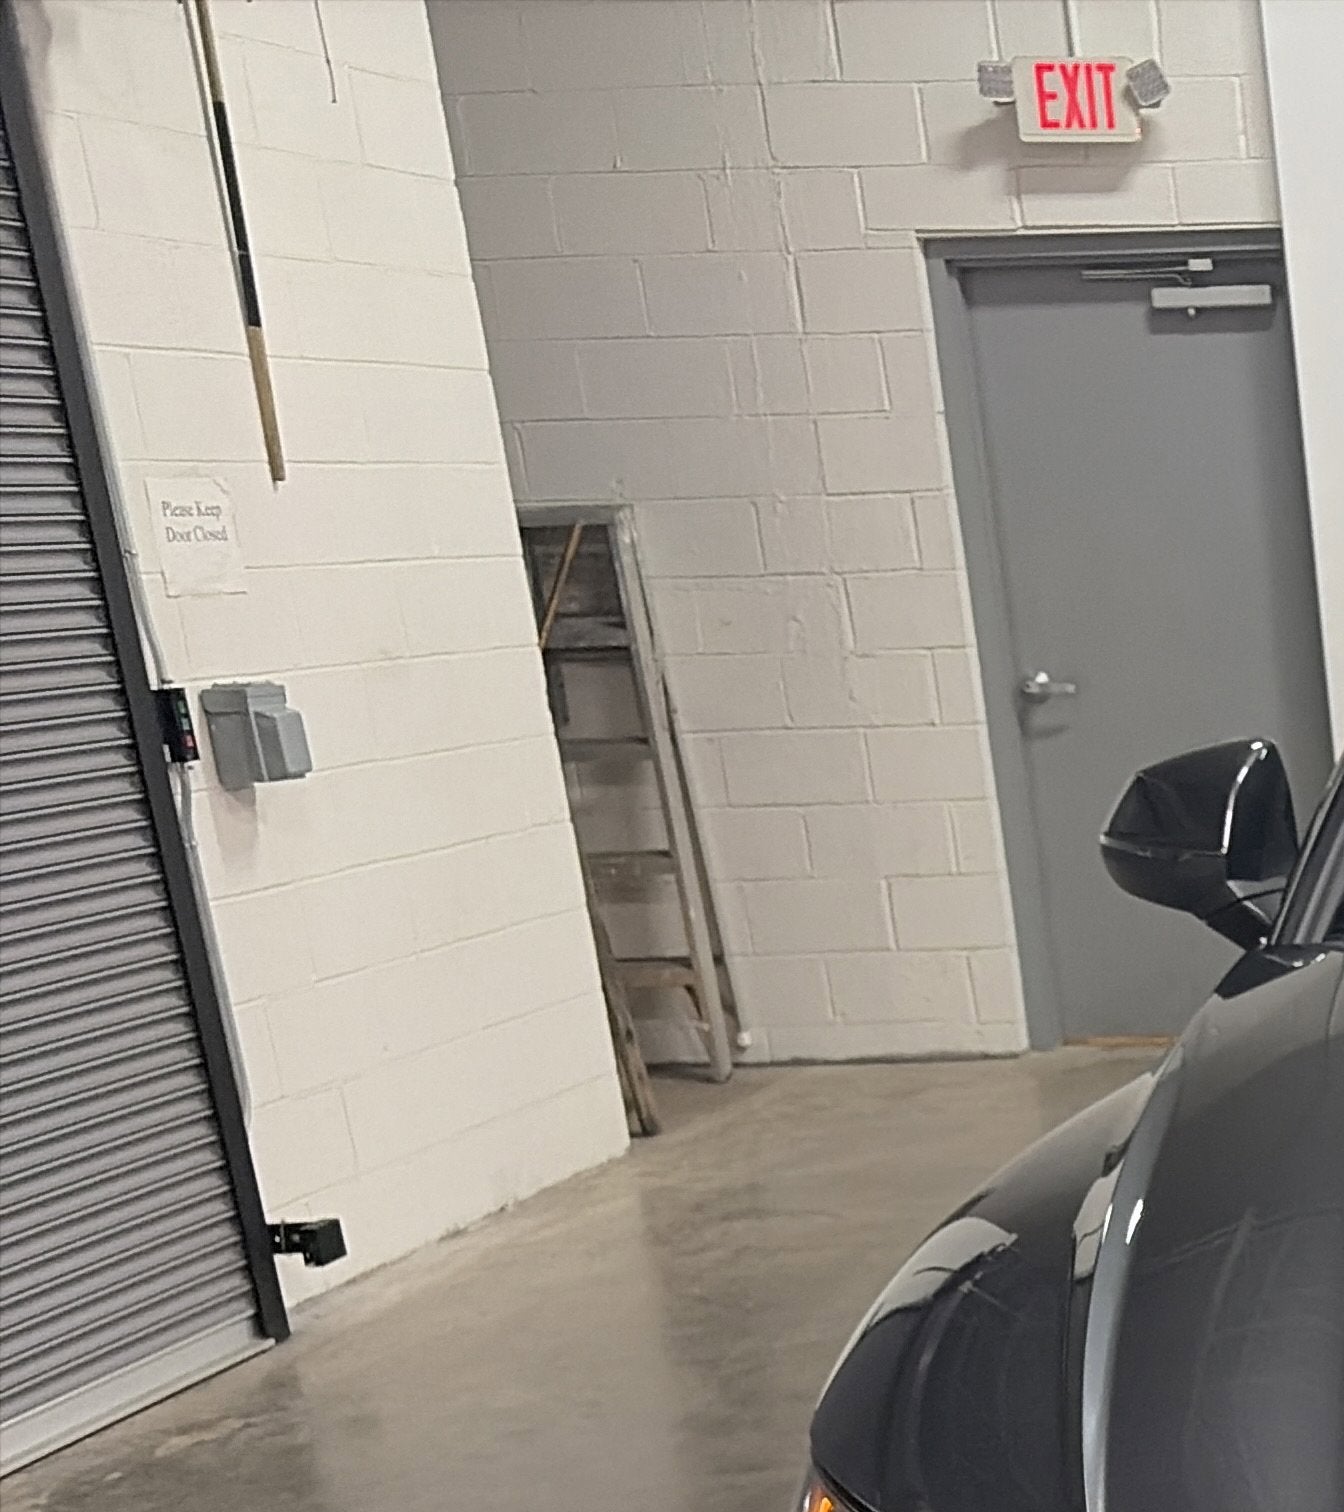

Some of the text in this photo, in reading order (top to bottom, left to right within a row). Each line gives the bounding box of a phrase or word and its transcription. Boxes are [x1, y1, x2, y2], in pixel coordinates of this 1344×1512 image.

[1034, 62, 1115, 130] EXIT
[161, 500, 222, 521] Please Keep
[165, 525, 228, 543] Door Closed
